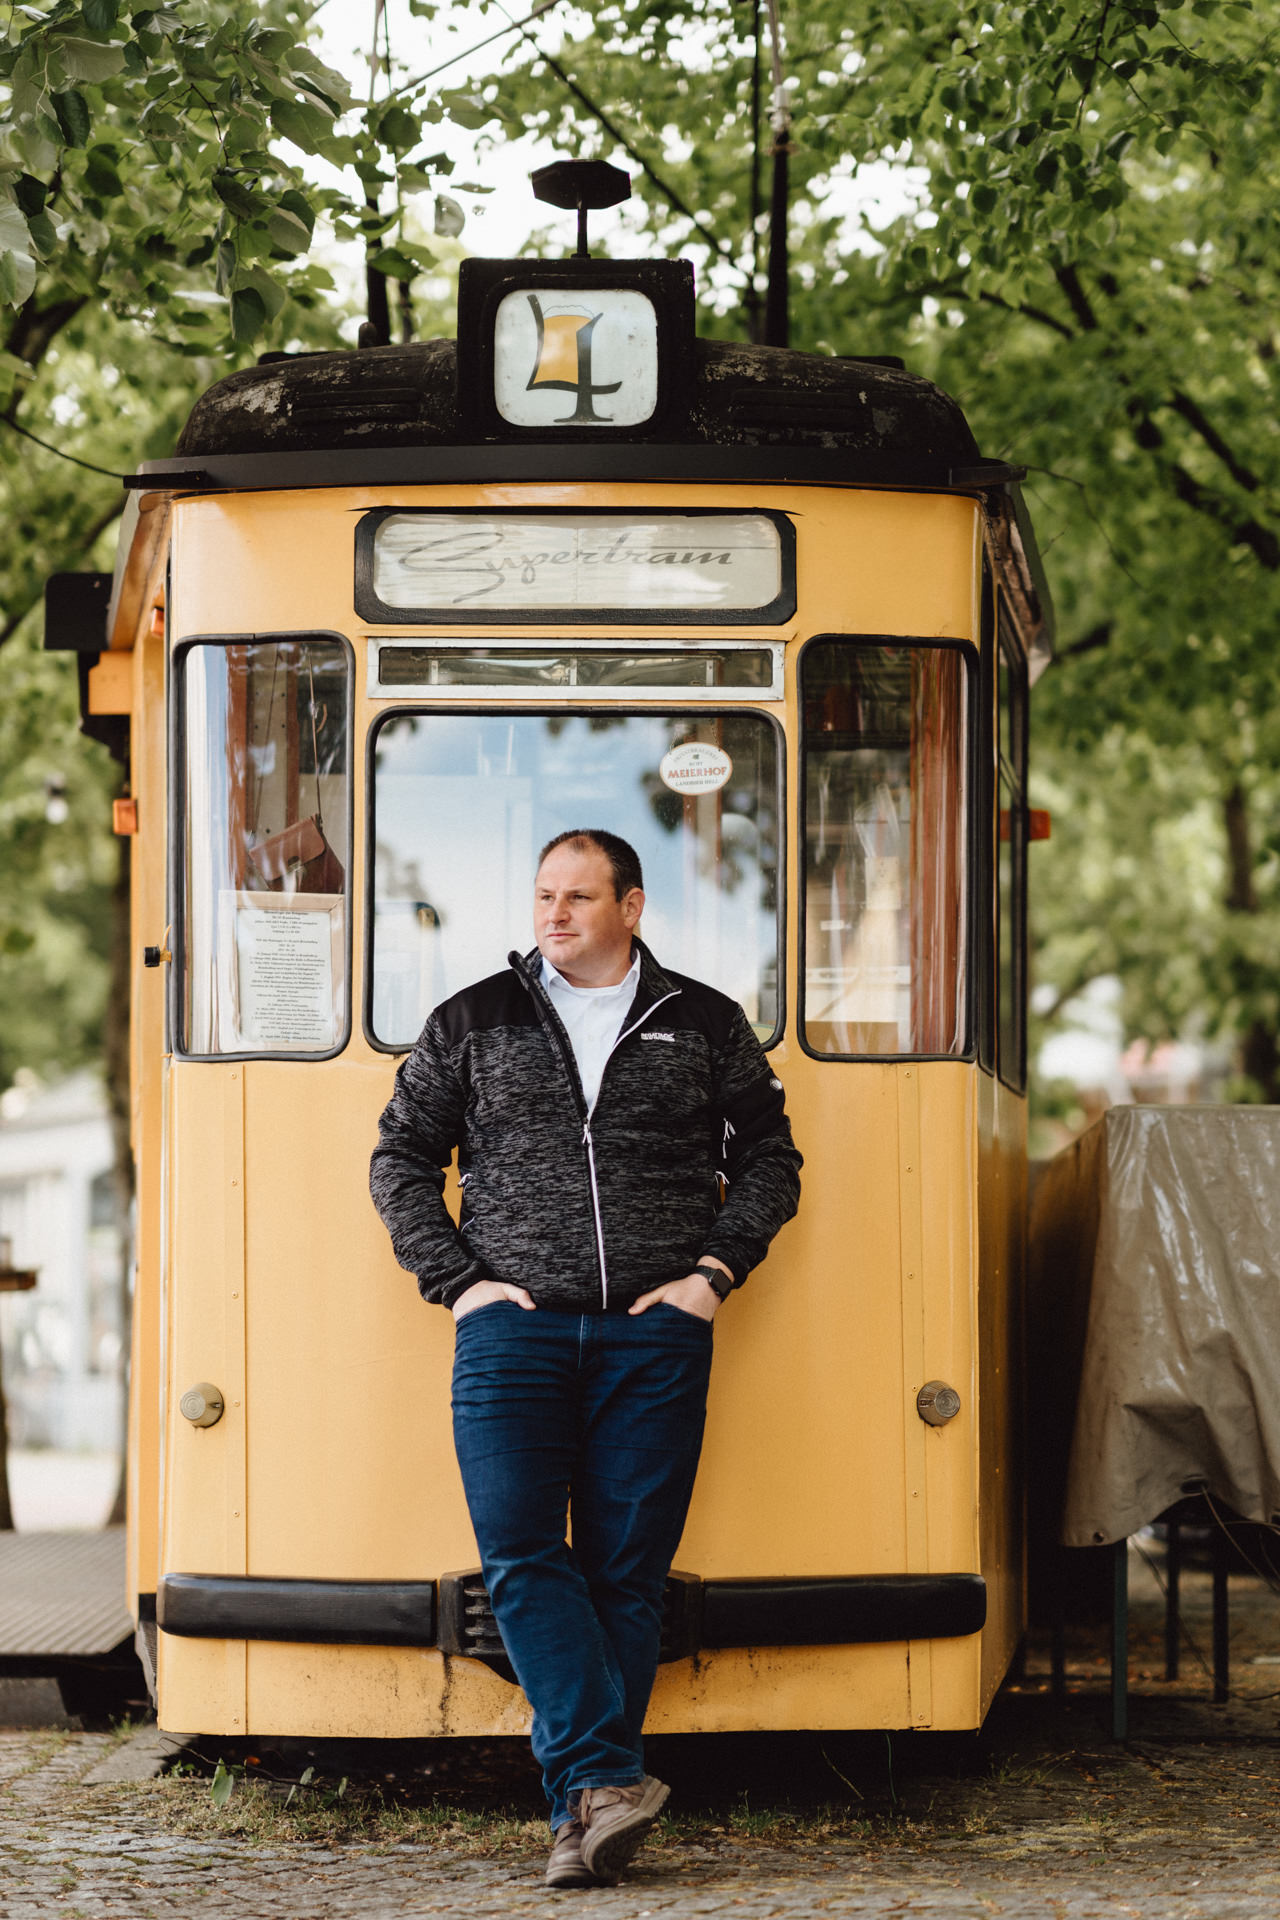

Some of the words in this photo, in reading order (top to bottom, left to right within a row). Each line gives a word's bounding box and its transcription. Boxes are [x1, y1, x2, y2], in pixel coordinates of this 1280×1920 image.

[526, 294, 623, 422] 4
[398, 531, 734, 604] Supertram
[668, 766, 727, 778] MEIERHOF
